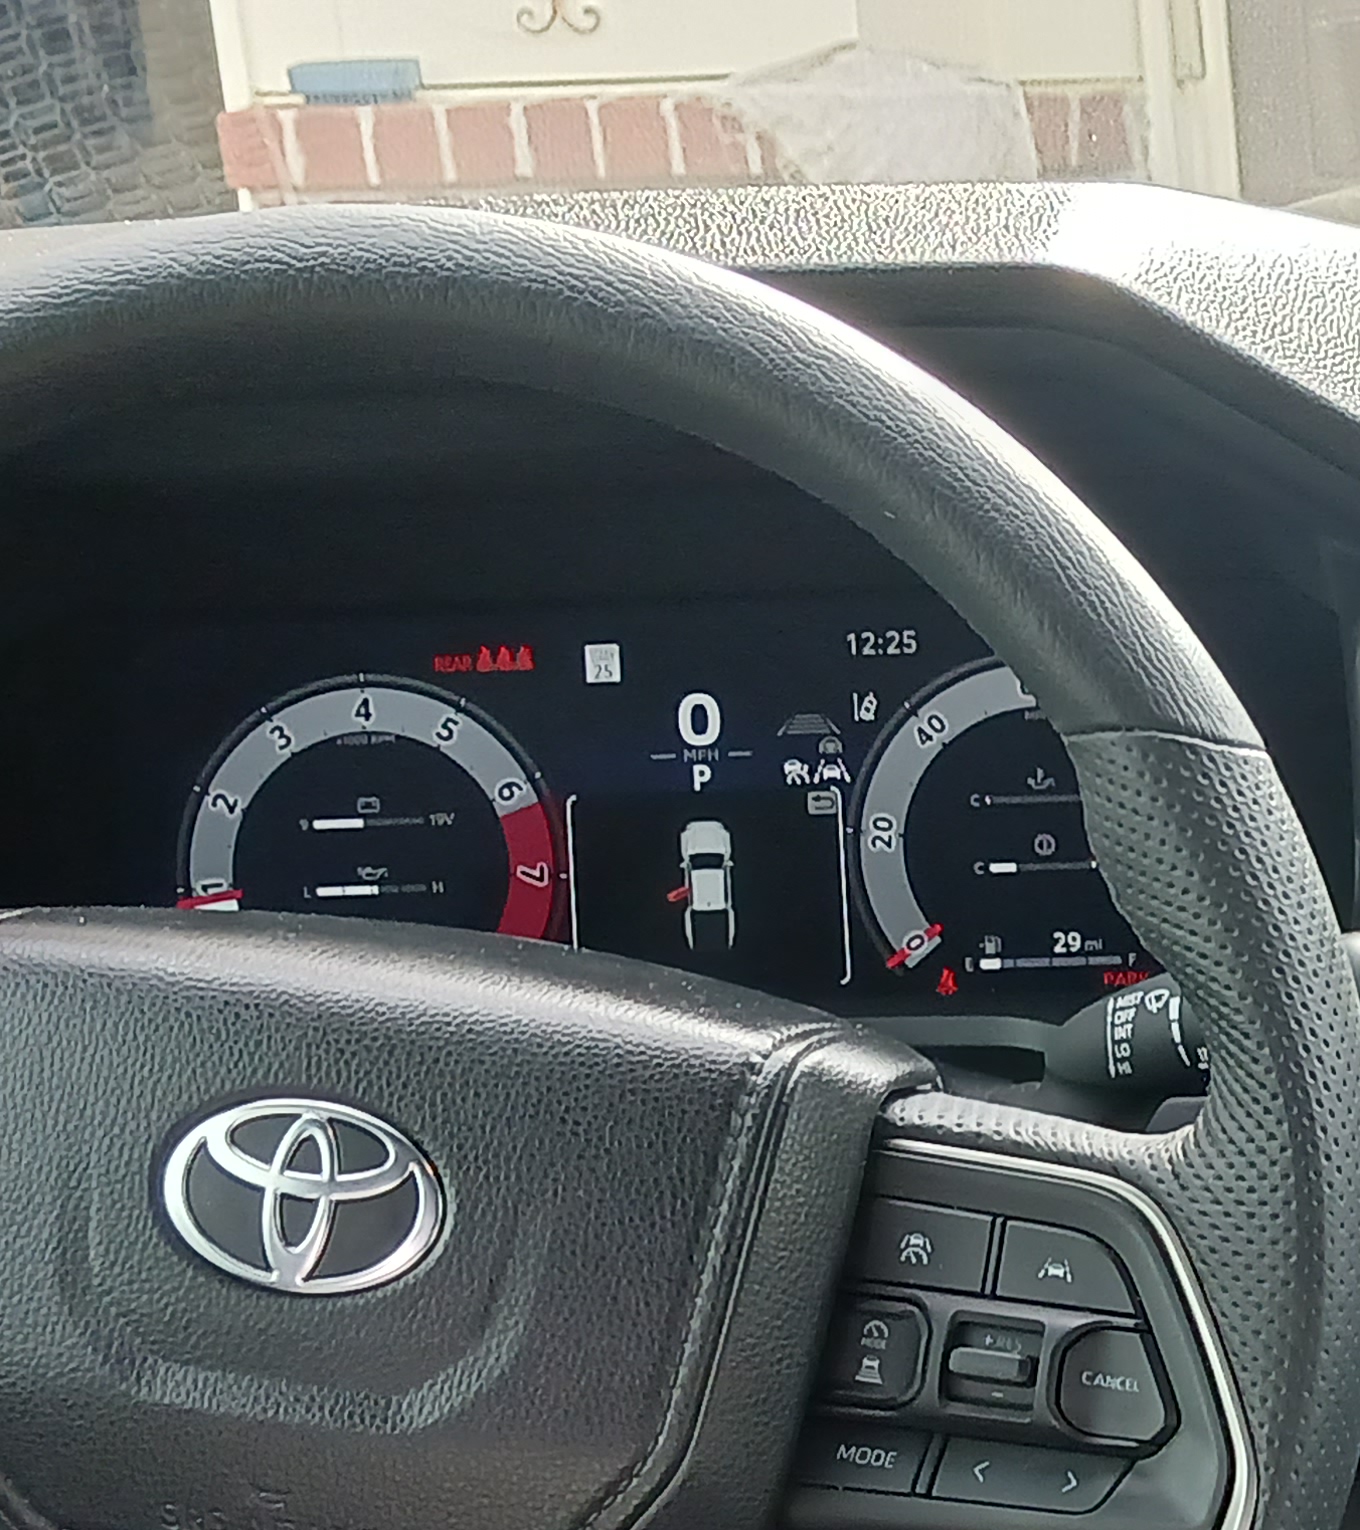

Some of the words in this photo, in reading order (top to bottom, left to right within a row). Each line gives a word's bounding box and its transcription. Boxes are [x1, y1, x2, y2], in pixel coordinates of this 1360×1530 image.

[846, 629, 917, 656] 12:25
[592, 660, 616, 682] 25
[353, 697, 374, 723] 4
[678, 692, 721, 747] 0
[268, 724, 291, 751] 3
[434, 716, 461, 743] 5
[915, 714, 946, 746] 40
[682, 746, 721, 764] MPH
[692, 763, 712, 792] P
[497, 780, 523, 803] 6
[210, 793, 237, 815] 2
[870, 815, 894, 852] 20
[517, 865, 549, 886] 7
[1052, 931, 1082, 954] 29
[1113, 1006, 1138, 1025] OFF
[1114, 1042, 1132, 1060] LO
[1081, 1371, 1140, 1393] CANCEL
[836, 1444, 898, 1469] MODE
